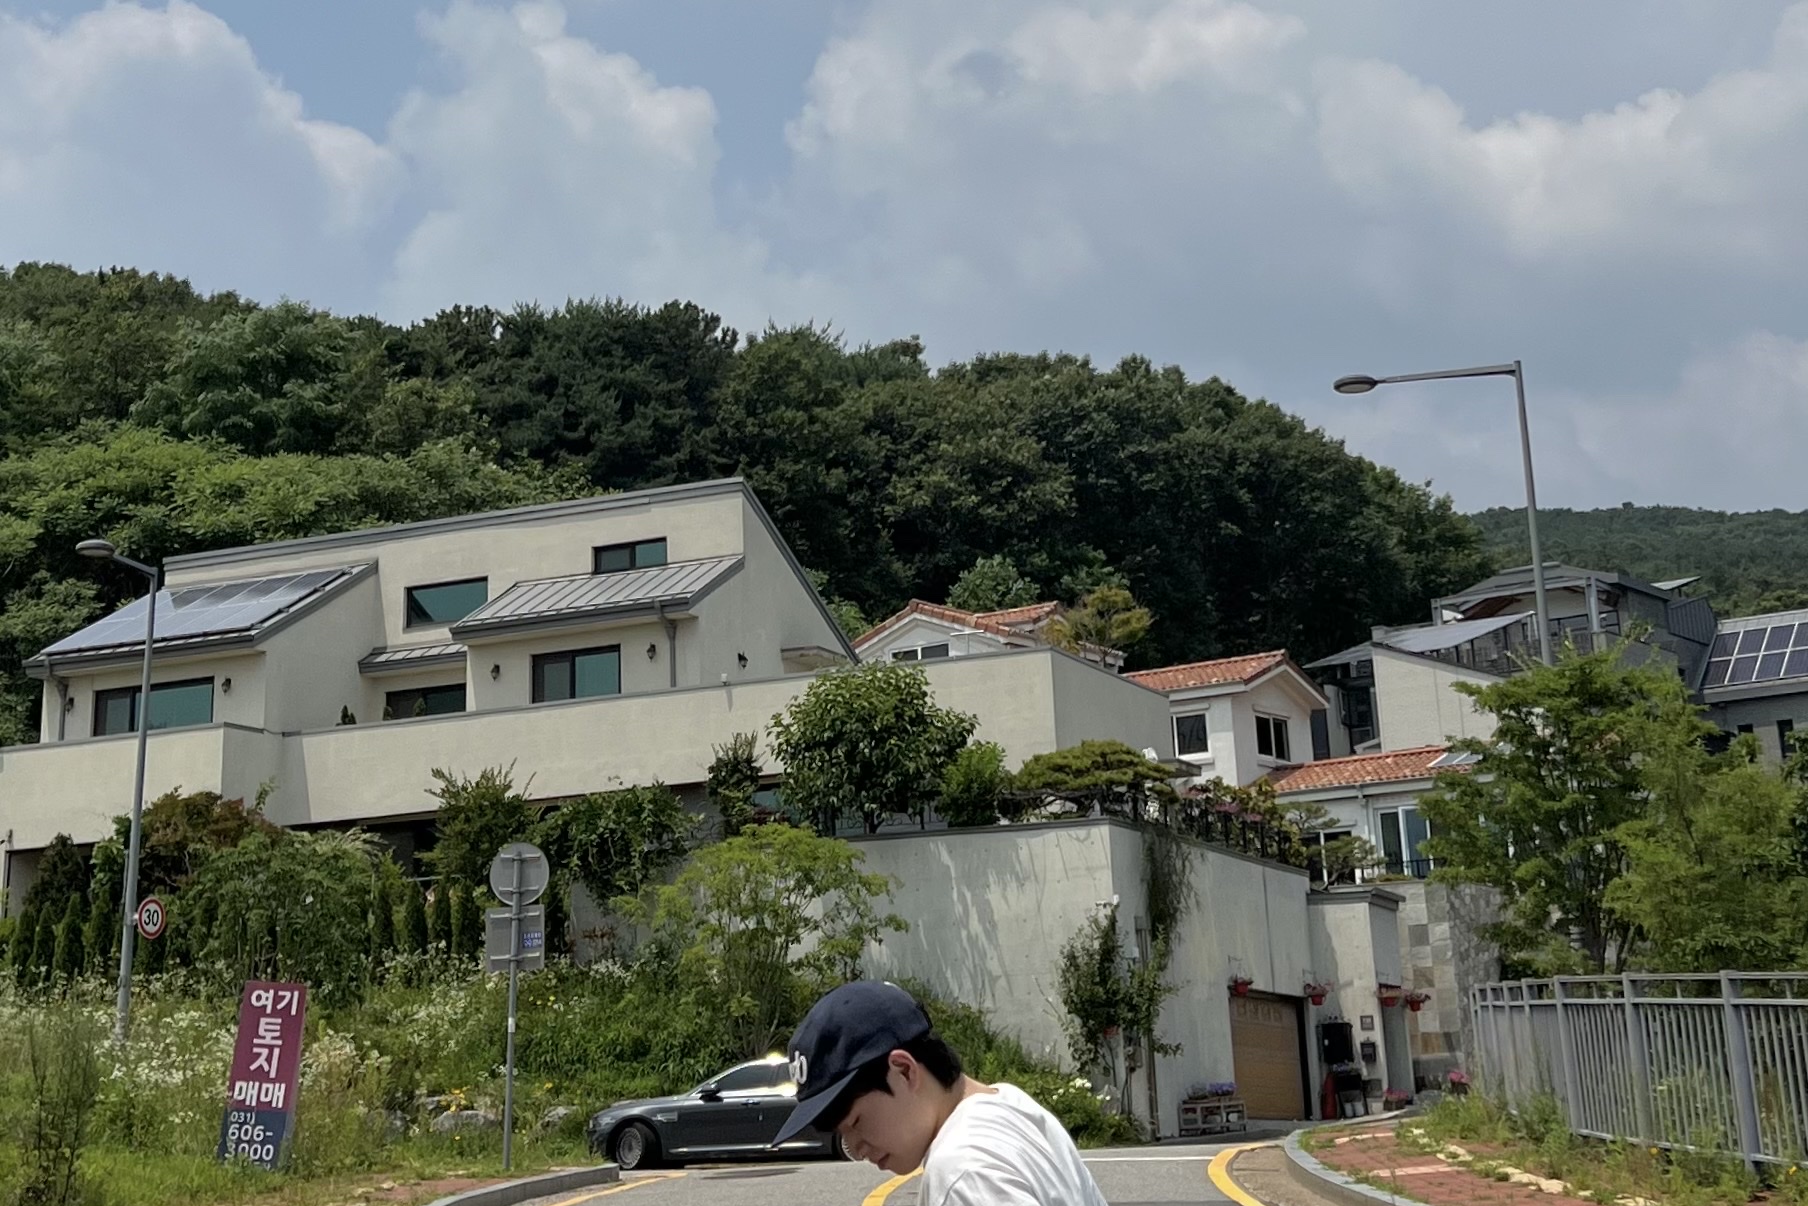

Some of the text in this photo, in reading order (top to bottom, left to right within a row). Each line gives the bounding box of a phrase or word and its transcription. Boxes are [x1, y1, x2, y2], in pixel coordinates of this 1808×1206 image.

[144, 908, 160, 927] 30
[250, 988, 299, 1016] 여기
[233, 1080, 286, 1109] 매매
[230, 1111, 256, 1125] 031)
[228, 1123, 274, 1142] 606-
